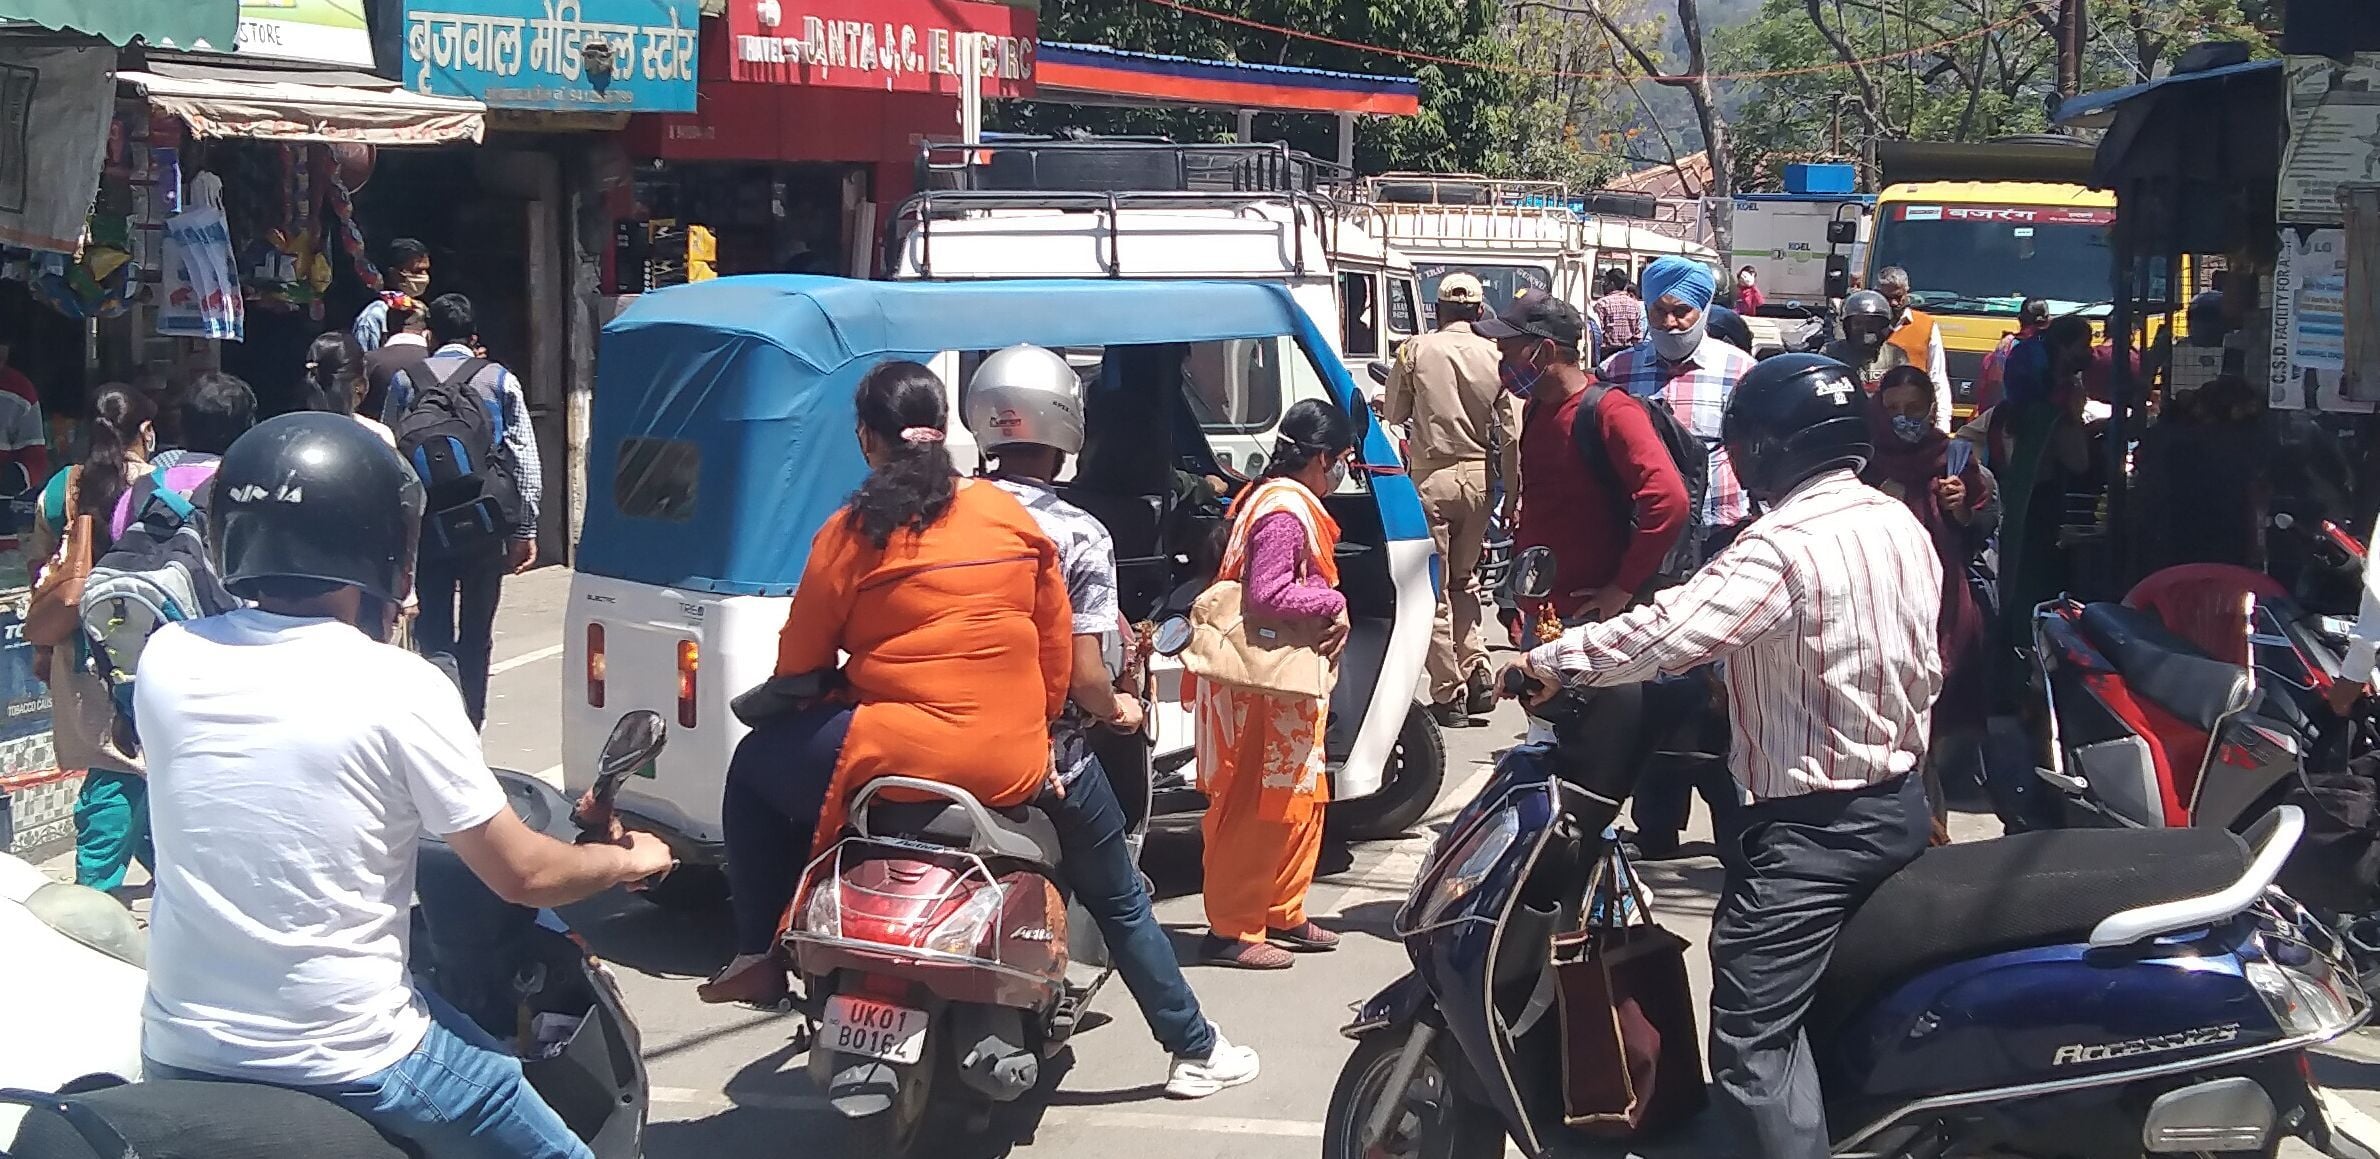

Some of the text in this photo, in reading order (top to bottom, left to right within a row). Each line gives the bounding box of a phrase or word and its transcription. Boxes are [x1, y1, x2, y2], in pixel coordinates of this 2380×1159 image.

[240, 22, 283, 46] STORE
[407, 10, 526, 95] बृजवाल
[641, 6, 697, 82] स्टोर
[1736, 202, 1760, 212] KOEL
[1947, 208, 2038, 222] बजरंग
[1788, 241, 1812, 251] KOEL
[2277, 270, 2291, 292] FOR
[2274, 294, 2289, 341] FACILITY
[2271, 343, 2288, 384] C.S.D.
[8, 700, 36, 717] TOBACCO
[850, 1003, 907, 1032] UK01
